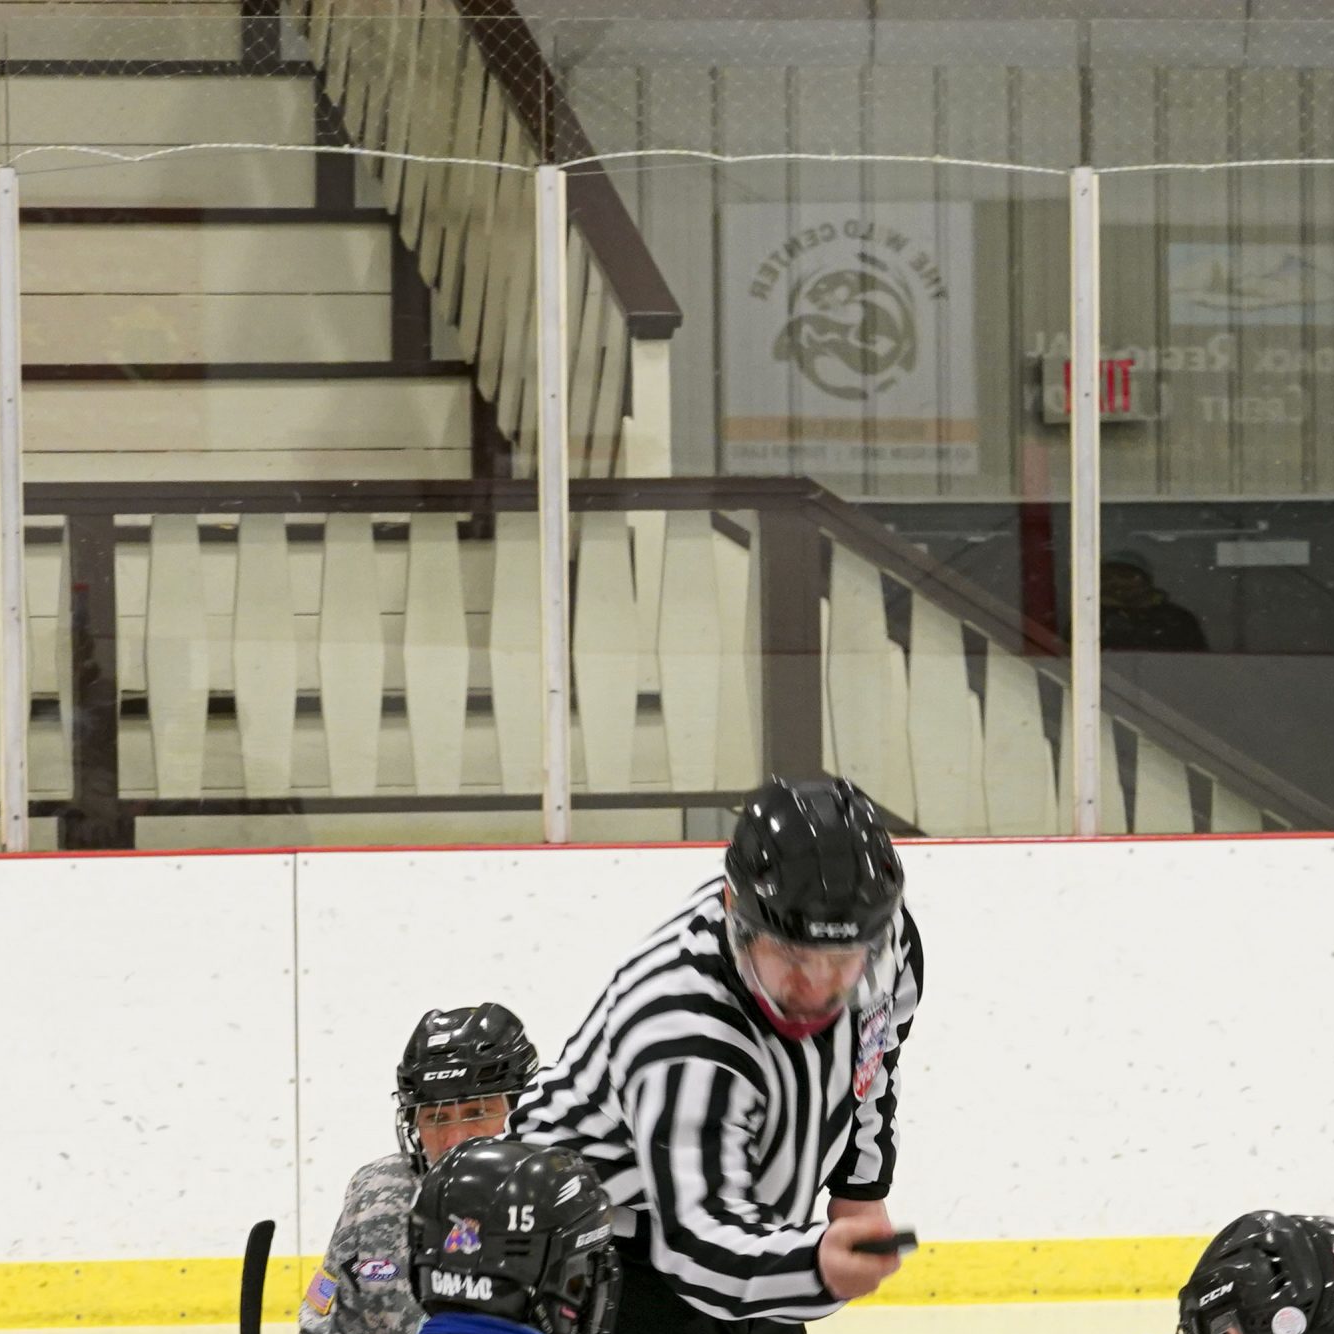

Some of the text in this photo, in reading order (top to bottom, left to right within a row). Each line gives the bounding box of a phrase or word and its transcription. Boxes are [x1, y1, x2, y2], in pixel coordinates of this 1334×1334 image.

[423, 1067, 468, 1081] CCM
[507, 1204, 535, 1233] 15
[1199, 1281, 1234, 1307] CCM
